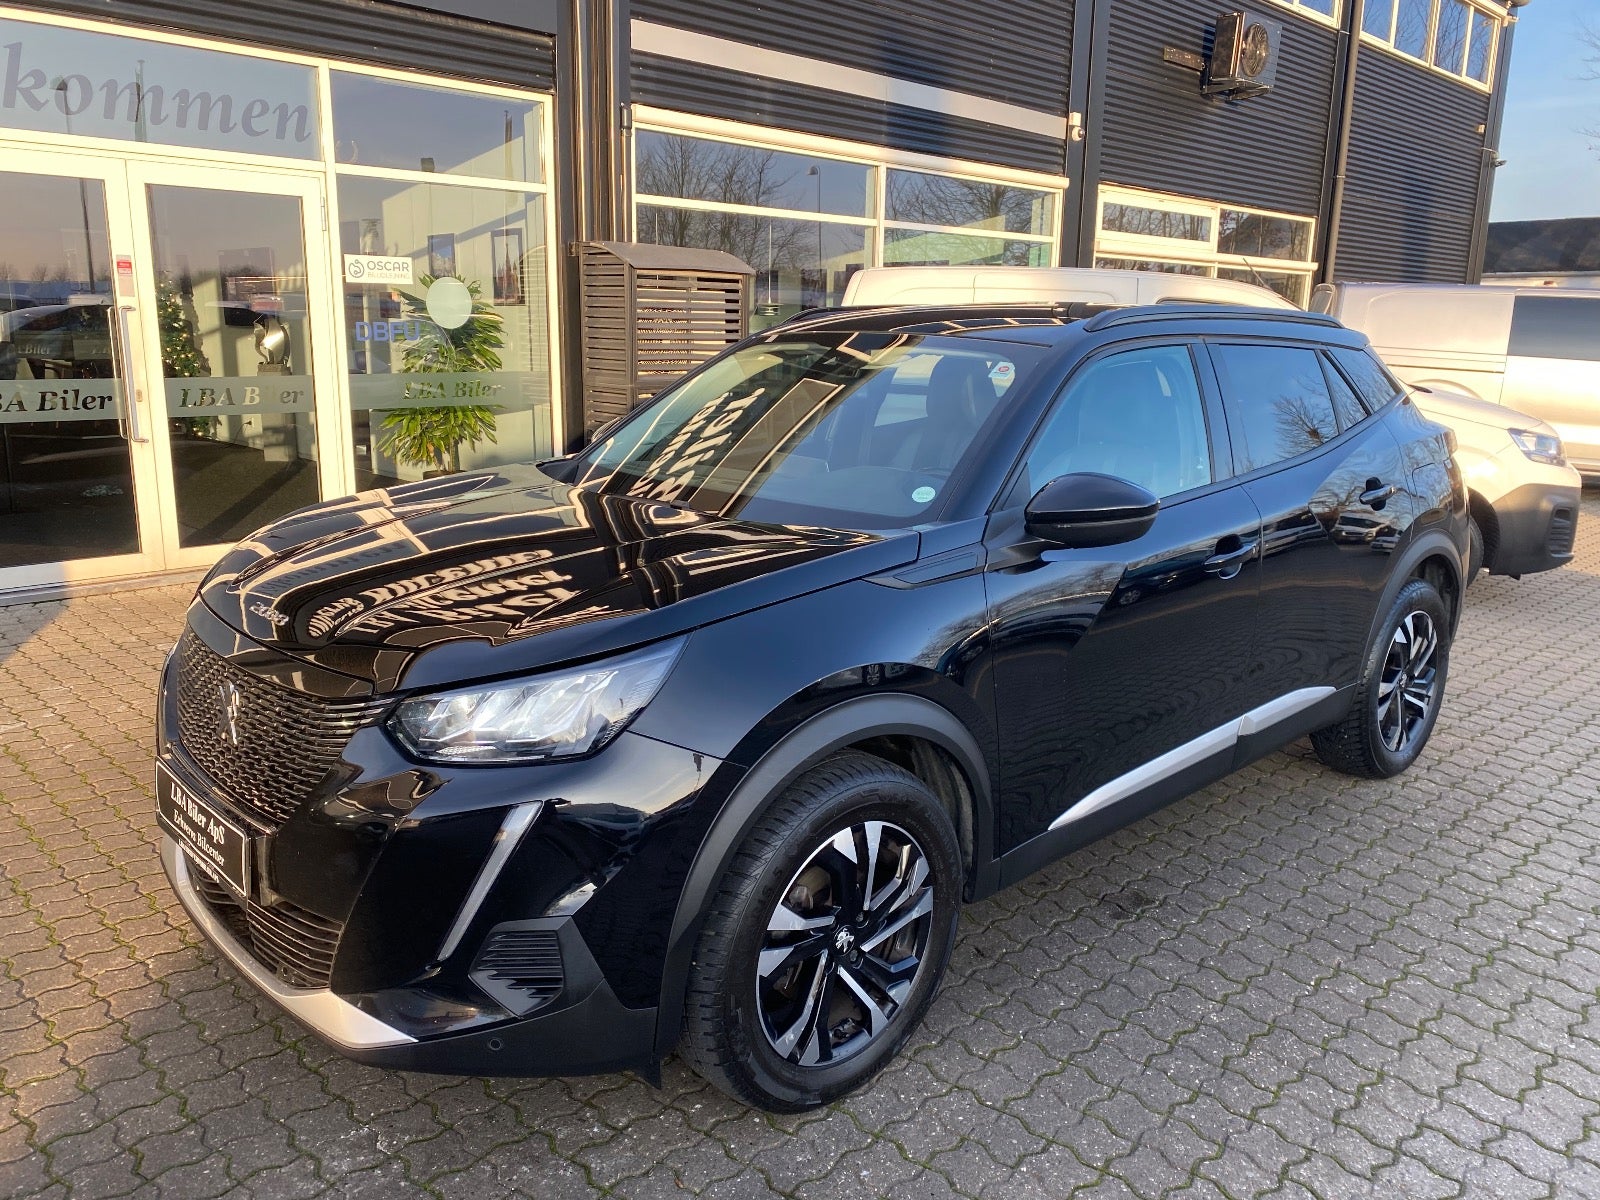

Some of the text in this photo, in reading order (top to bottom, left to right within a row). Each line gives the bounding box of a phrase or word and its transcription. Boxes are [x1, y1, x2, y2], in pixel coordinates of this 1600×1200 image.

[2, 41, 311, 142] kommen
[366, 260, 410, 272] OSCAR
[355, 321, 419, 342] DBFU
[36, 388, 113, 412] Biler
[178, 387, 236, 408] LBA
[452, 380, 505, 398] Biler
[171, 783, 225, 844] LBA Biler ApS
[197, 832, 225, 866] Bilcenter
